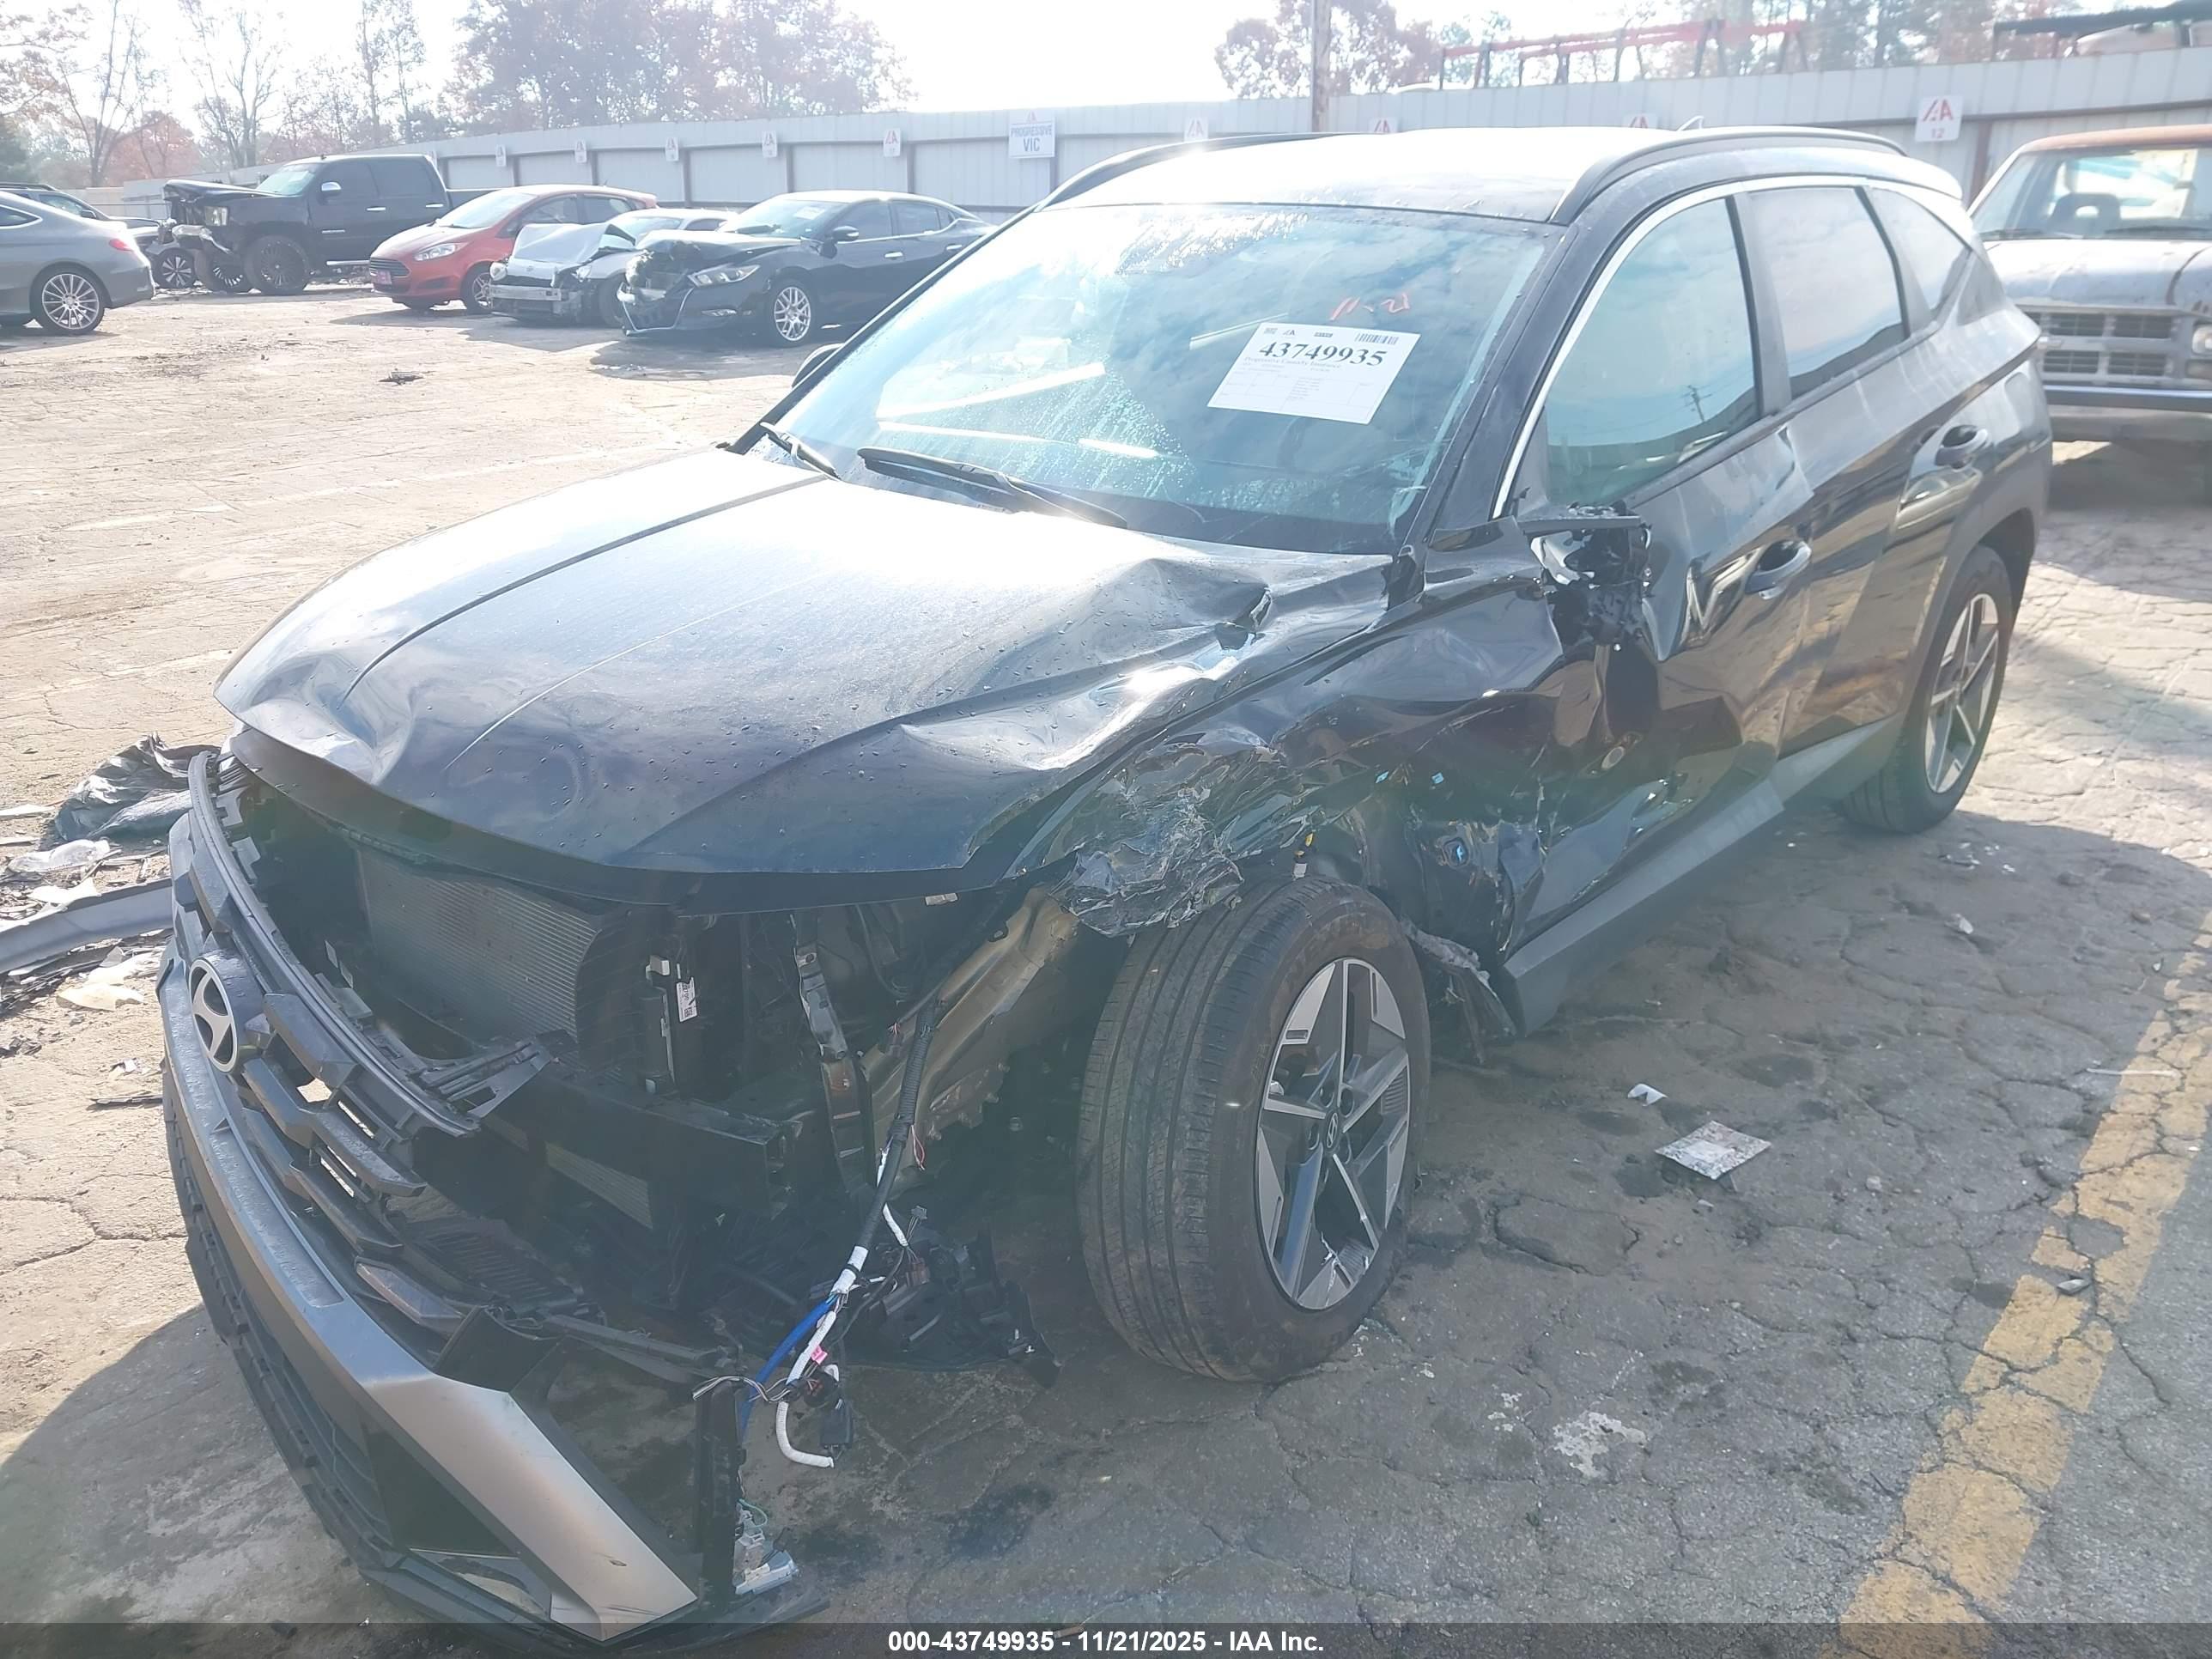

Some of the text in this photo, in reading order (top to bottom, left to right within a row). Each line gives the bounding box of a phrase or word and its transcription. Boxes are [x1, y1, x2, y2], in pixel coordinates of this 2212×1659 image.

[1010, 125, 1052, 137] PROGRESSIVE
[1023, 137, 1041, 152] VIC
[1259, 342, 1388, 366] 43749935
